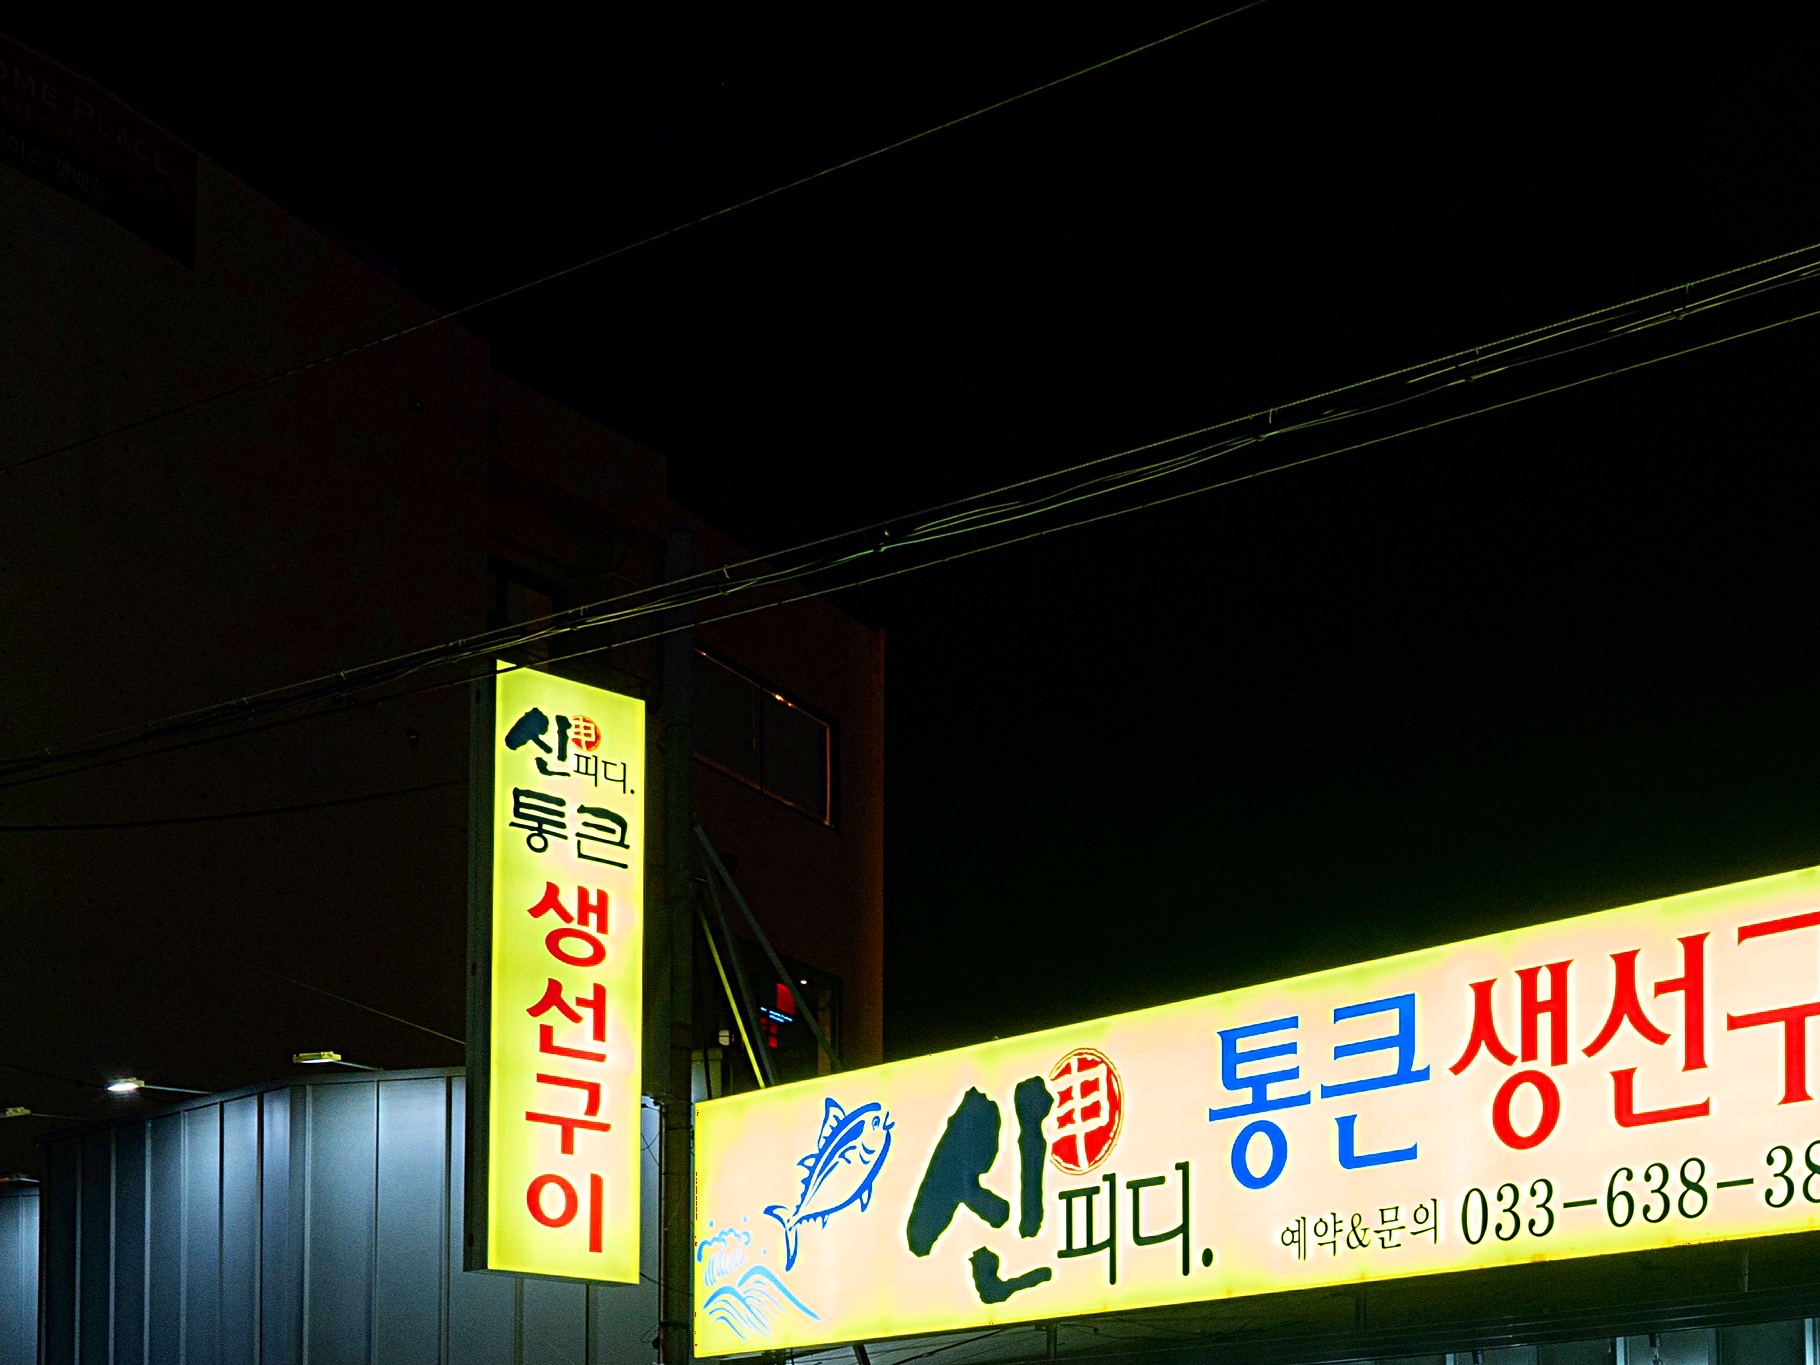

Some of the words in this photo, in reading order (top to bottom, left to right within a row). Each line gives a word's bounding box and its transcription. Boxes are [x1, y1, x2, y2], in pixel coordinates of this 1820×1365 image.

[509, 786, 630, 869] 통큰
[526, 880, 611, 1254] 생선구이
[1209, 992, 1430, 1191] 통큰
[1280, 1197, 1440, 1262] 예약&문의
